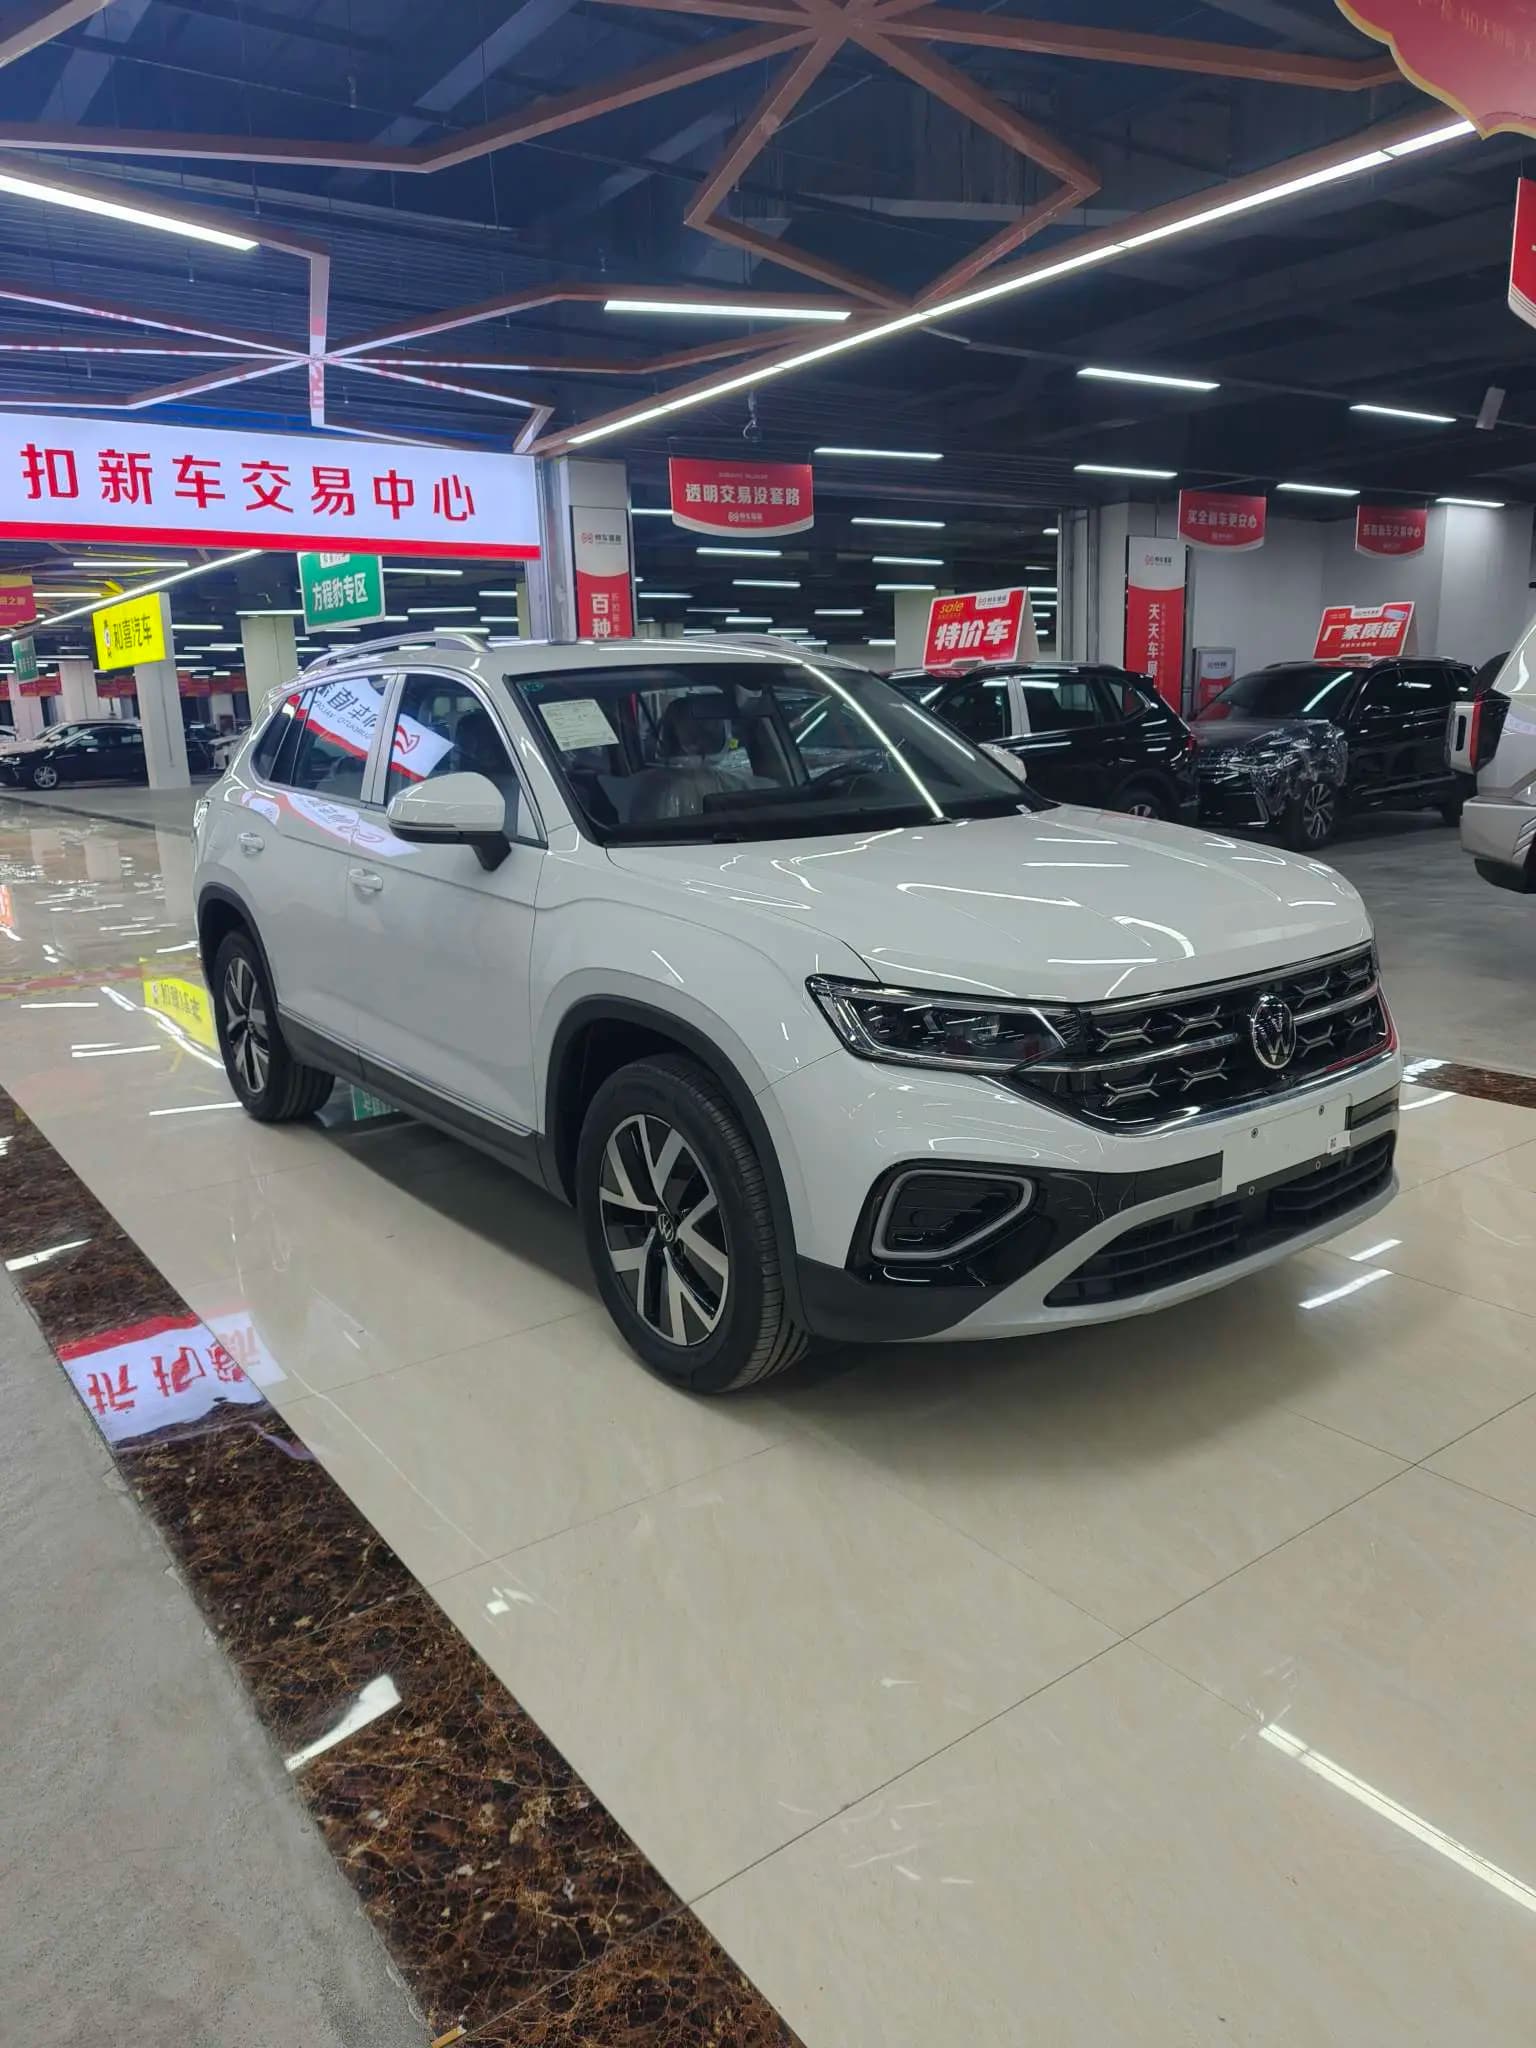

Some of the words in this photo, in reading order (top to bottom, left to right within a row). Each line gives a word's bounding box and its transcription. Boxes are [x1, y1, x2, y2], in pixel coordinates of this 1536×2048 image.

[20, 443, 476, 522] 扣新车交易中心
[685, 483, 800, 506] 透明交易没套路
[934, 618, 1012, 651] 特价车
[1322, 621, 1402, 642] 厂家质保
